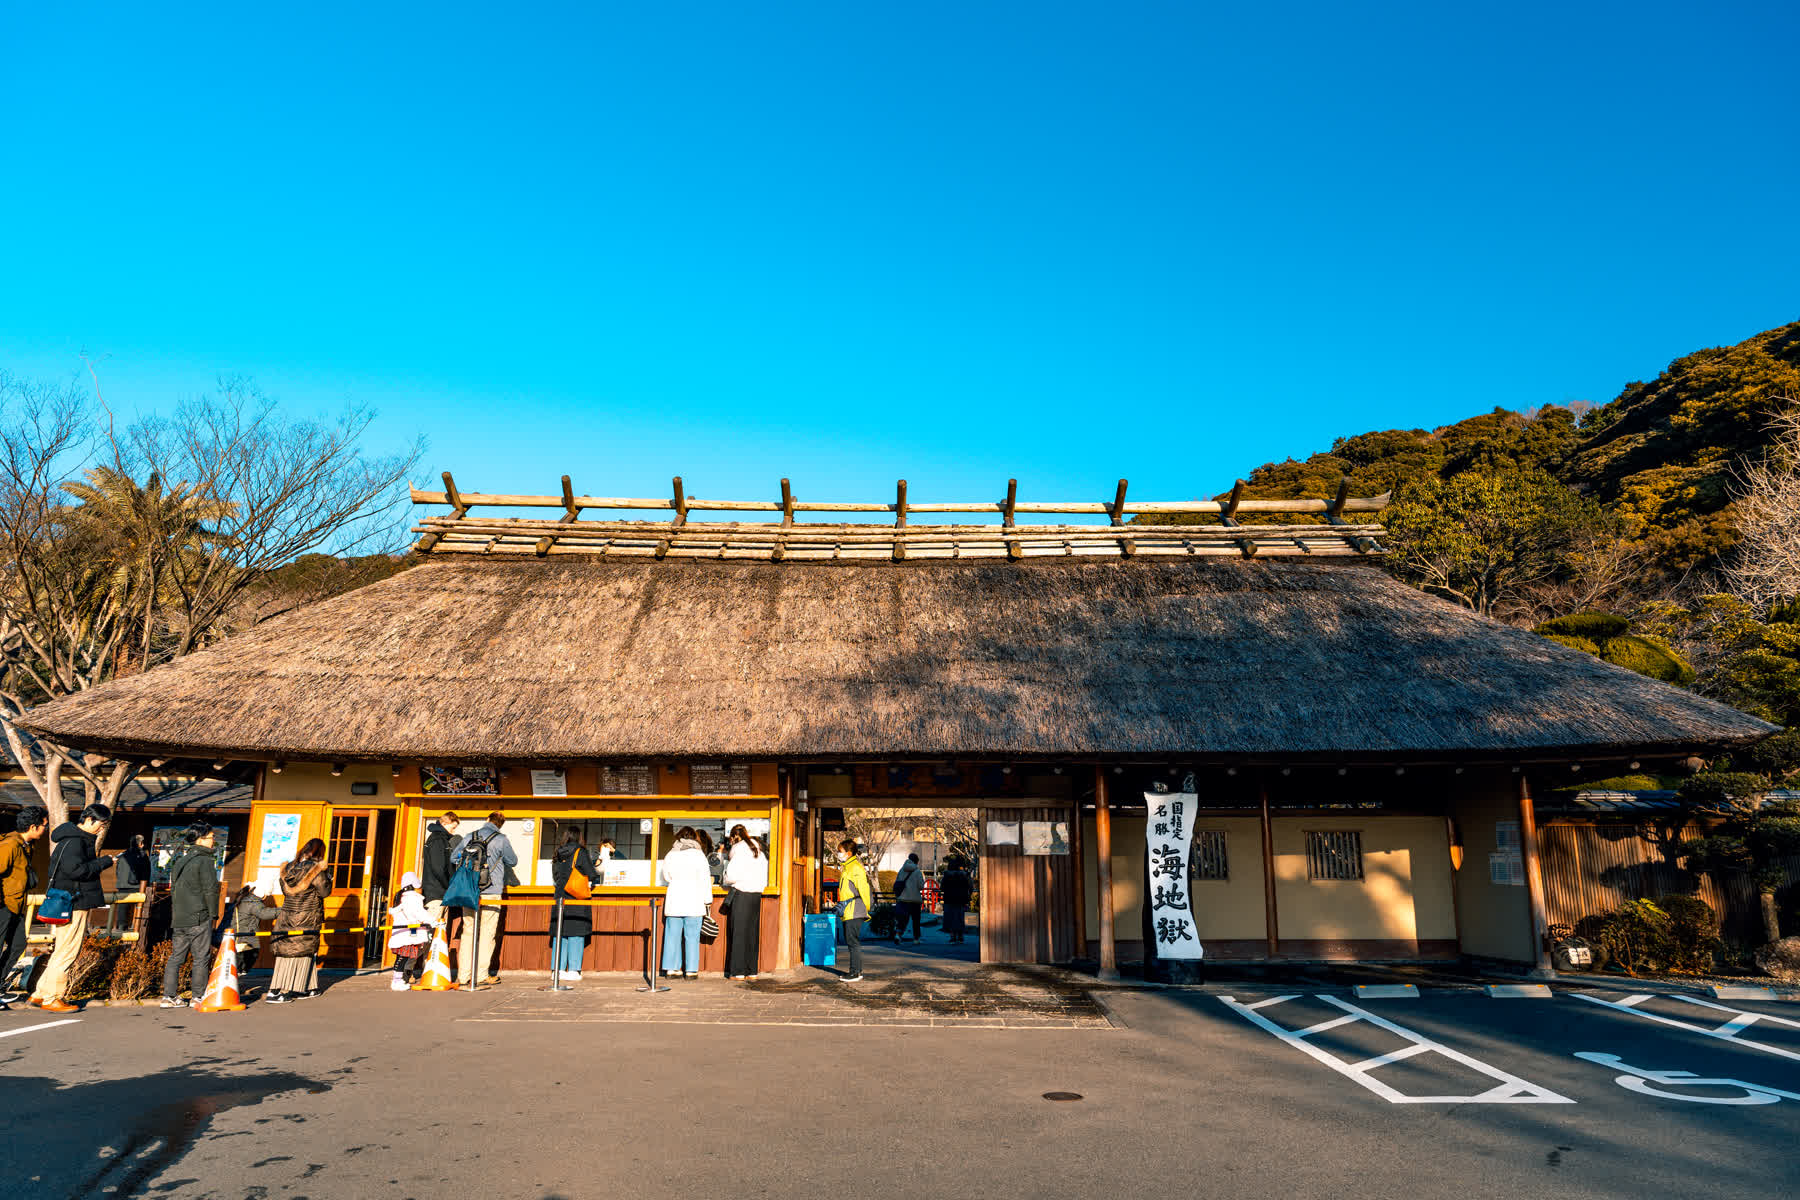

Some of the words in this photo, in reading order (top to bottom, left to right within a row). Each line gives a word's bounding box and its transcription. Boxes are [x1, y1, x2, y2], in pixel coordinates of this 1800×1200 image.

[1154, 804, 1170, 836] 名勝
[1171, 801, 1184, 841] 国指定
[1152, 844, 1193, 945] 海地獄
